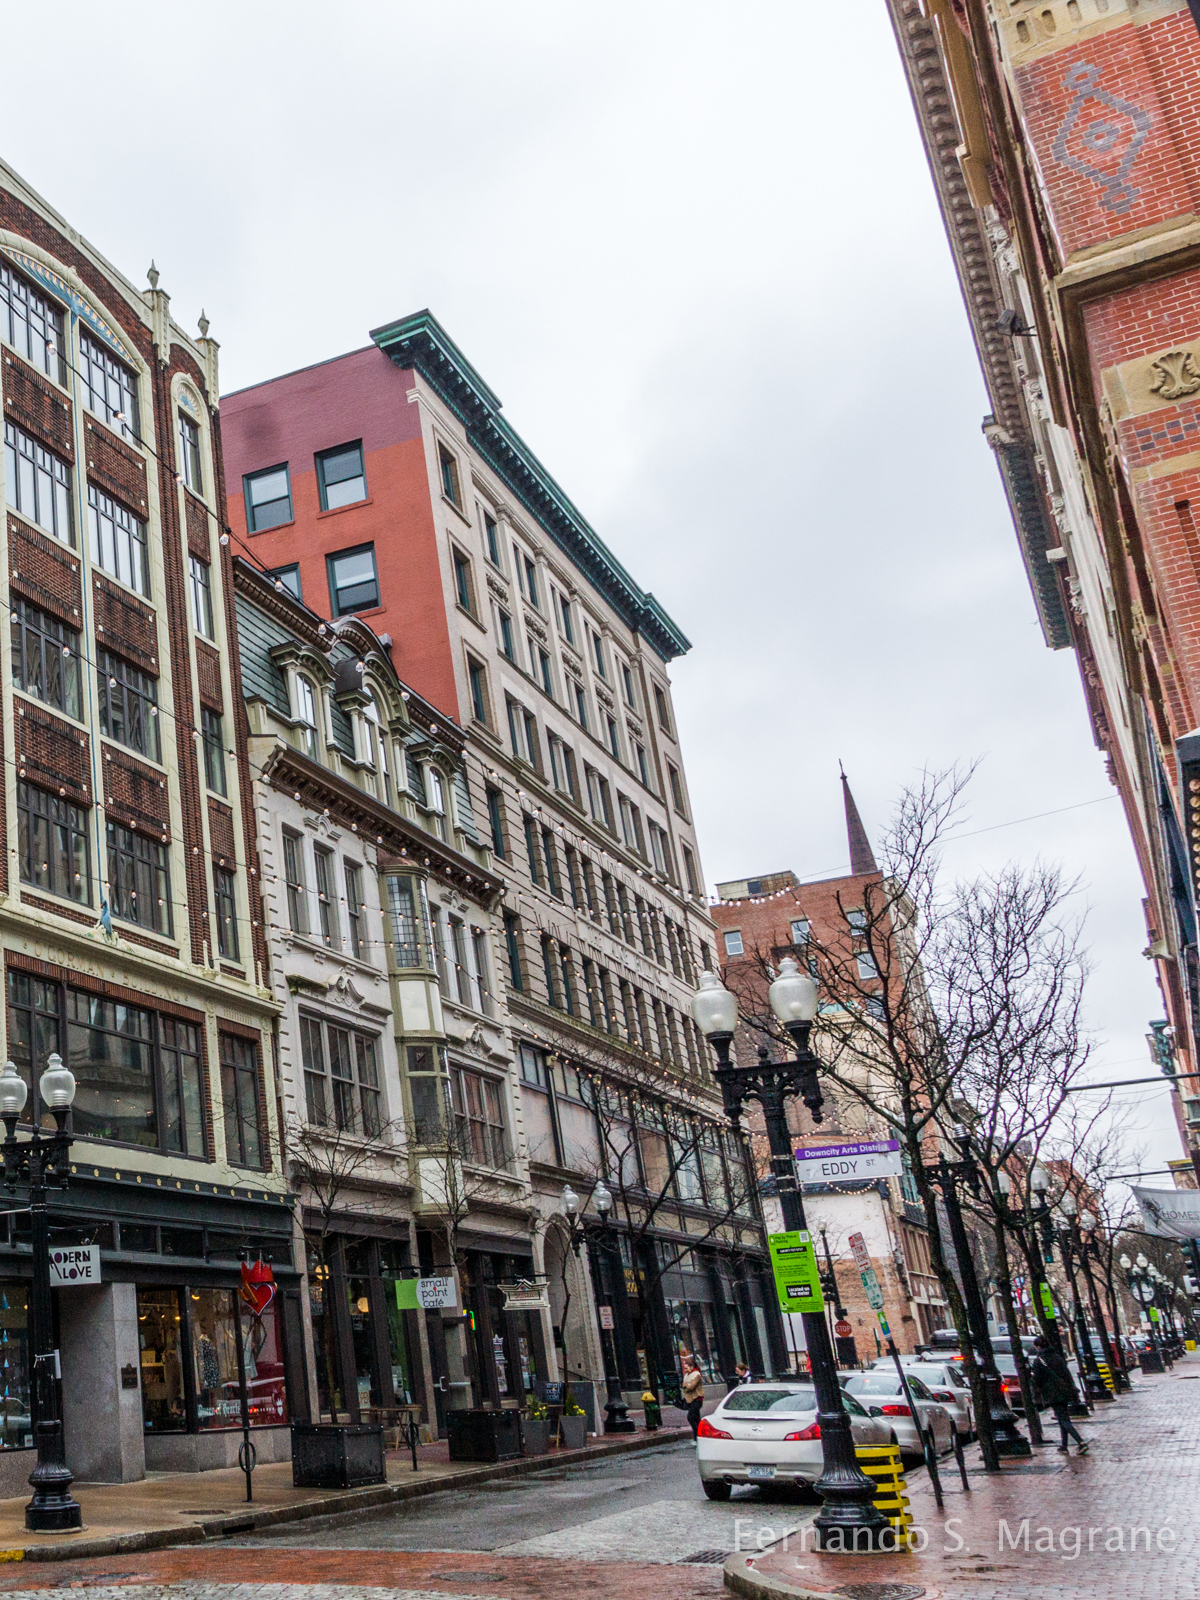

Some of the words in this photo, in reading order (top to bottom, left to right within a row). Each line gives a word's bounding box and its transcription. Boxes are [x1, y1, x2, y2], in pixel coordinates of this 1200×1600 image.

[804, 1148, 840, 1158] Downcity
[841, 1146, 858, 1154] Arts
[860, 1143, 890, 1152] Distri
[821, 1160, 858, 1176] EDDY
[62, 1263, 92, 1280] LOVE
[420, 1277, 449, 1288] small
[421, 1287, 448, 1300] point
[422, 1299, 444, 1308] café
[835, 1325, 851, 1333] STOP
